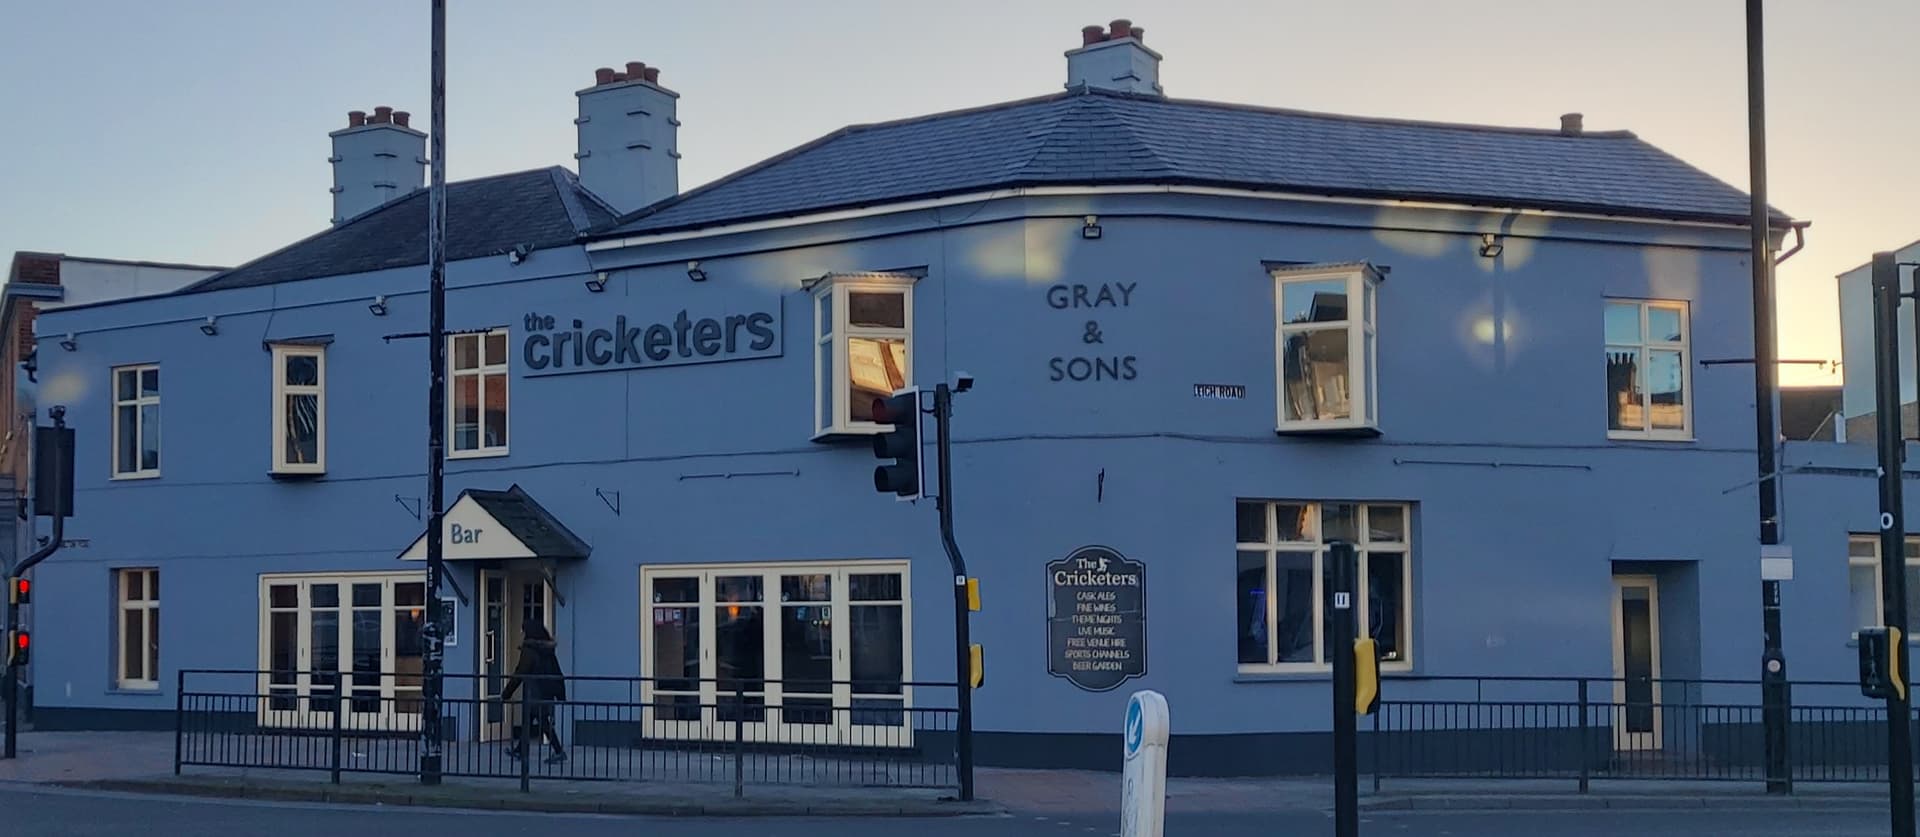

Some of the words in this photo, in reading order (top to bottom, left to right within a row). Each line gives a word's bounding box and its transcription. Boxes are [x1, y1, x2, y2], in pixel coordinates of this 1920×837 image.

[1048, 283, 1137, 309] GRAY
[524, 312, 555, 332] the
[1082, 320, 1104, 344] &
[523, 309, 774, 370] cricketers
[1049, 356, 1138, 382] SONS
[1194, 385, 1216, 399] LEIGH
[1219, 386, 1244, 399] ROAD
[451, 523, 483, 544] Bar
[1076, 558, 1097, 569] The
[1055, 570, 1137, 586] Cricketers
[1077, 592, 1096, 601] CASK
[1097, 592, 1116, 601] ALES
[1077, 603, 1093, 612] FINE
[1093, 603, 1116, 612] WINES
[1072, 615, 1096, 624] THEME
[1096, 615, 1122, 624] NIGHTS
[1078, 627, 1092, 636] LIVE
[1093, 627, 1115, 636] MUSIC
[1068, 638, 1086, 647] FREE
[1086, 638, 1110, 647] VENUE
[1111, 639, 1127, 647] HIRE
[1065, 650, 1091, 659] SPORTS
[1092, 650, 1130, 659] CHANNELS
[1073, 662, 1091, 671] BEER
[1092, 662, 1122, 671] GARDEN
